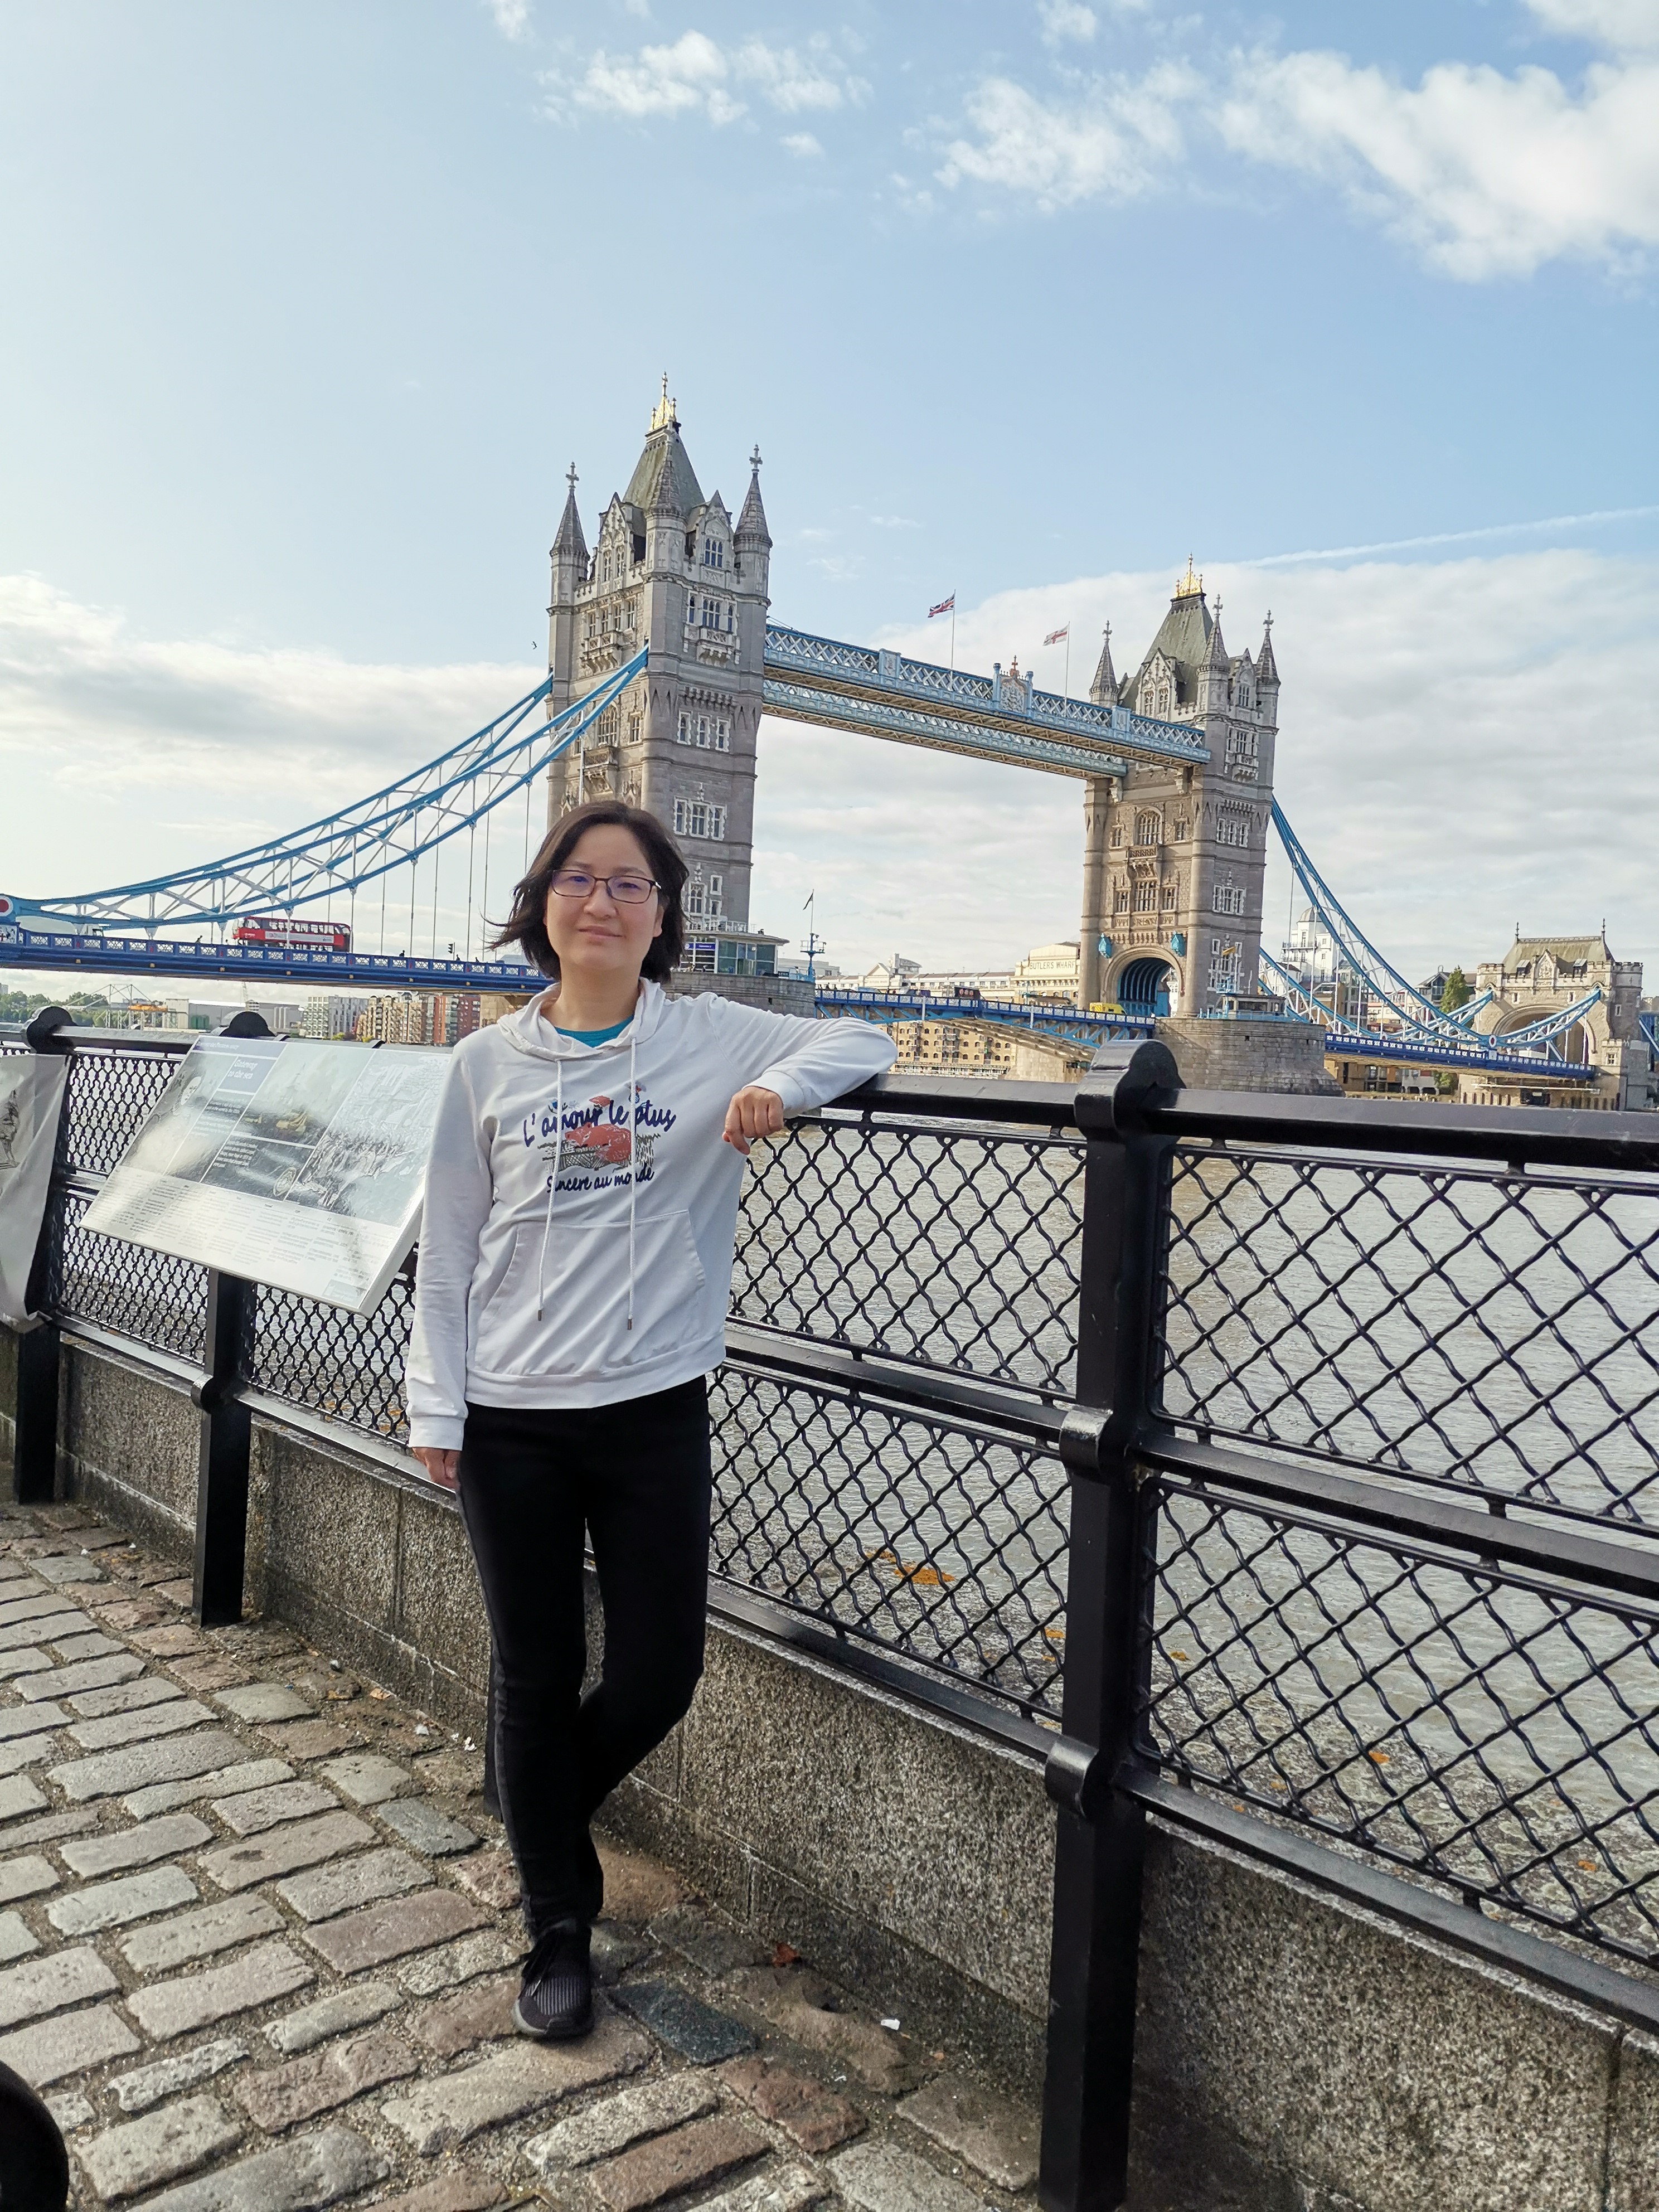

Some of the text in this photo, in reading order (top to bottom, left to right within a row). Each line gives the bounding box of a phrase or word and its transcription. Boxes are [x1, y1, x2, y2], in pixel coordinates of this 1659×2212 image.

[234, 1059, 258, 1071] Gateway
[234, 1070, 244, 1078] the
[609, 1099, 630, 1126] le
[634, 1099, 677, 1136] plus
[546, 1175, 592, 1194] Sncere
[594, 1176, 612, 1190] au
